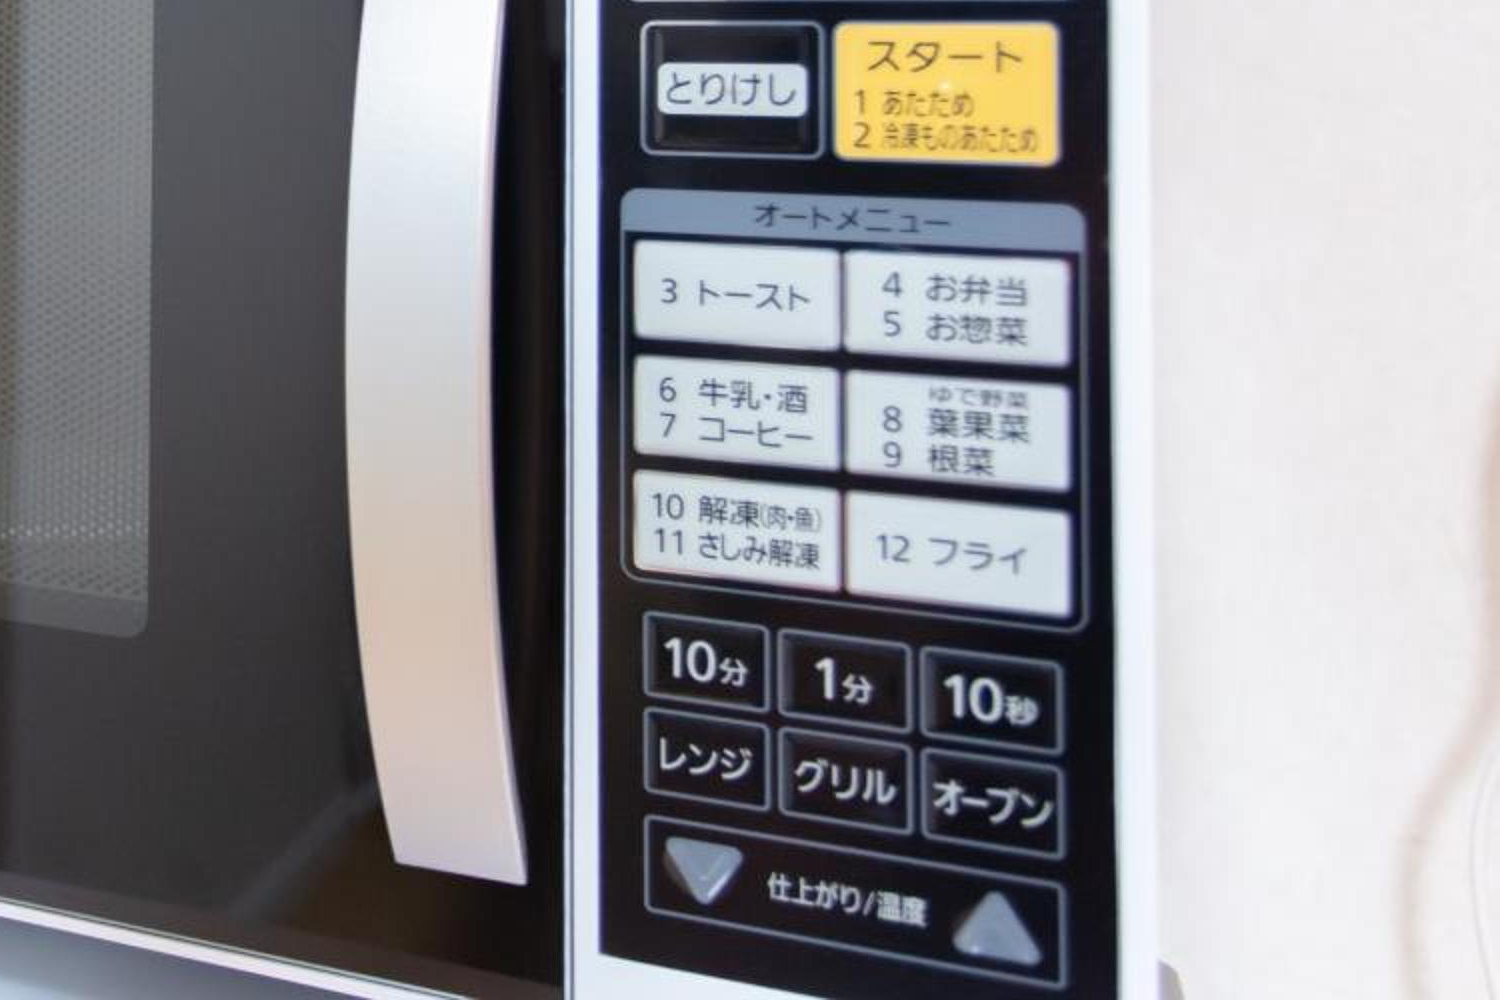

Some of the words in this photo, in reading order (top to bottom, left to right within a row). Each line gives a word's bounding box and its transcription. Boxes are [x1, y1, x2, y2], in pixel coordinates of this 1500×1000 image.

[867, 40, 1023, 73] スタート
[664, 71, 797, 107] とりけし
[854, 89, 866, 115] 1
[883, 90, 976, 118] あたため
[853, 122, 871, 149] 2
[882, 123, 1038, 153] 冷凍ものあたため
[754, 203, 951, 234] オートメニュー
[660, 278, 678, 304] 3
[698, 280, 812, 313] トースト
[881, 272, 903, 299] 4
[925, 273, 1029, 308] お弁当
[883, 311, 902, 338] 5
[925, 313, 1029, 348] お惣菜
[659, 377, 677, 403] 6
[928, 386, 1030, 410] ゆで野菜
[659, 413, 677, 439] 7
[697, 416, 814, 449] コーヒー
[882, 405, 903, 433] 8
[928, 408, 1031, 444] 葉果菜
[883, 441, 902, 468] 9
[928, 444, 996, 476] 根菜
[652, 493, 685, 520] 10
[654, 528, 684, 556] 11
[698, 533, 820, 570] さしみ解凍
[877, 534, 911, 564] 12
[929, 538, 1029, 575] フライ
[664, 636, 750, 688] 10分
[814, 657, 875, 705] 1分
[944, 673, 1041, 727] 10秒
[659, 738, 754, 780] レンジ
[794, 760, 896, 806] グリル
[933, 779, 1054, 830] オープン
